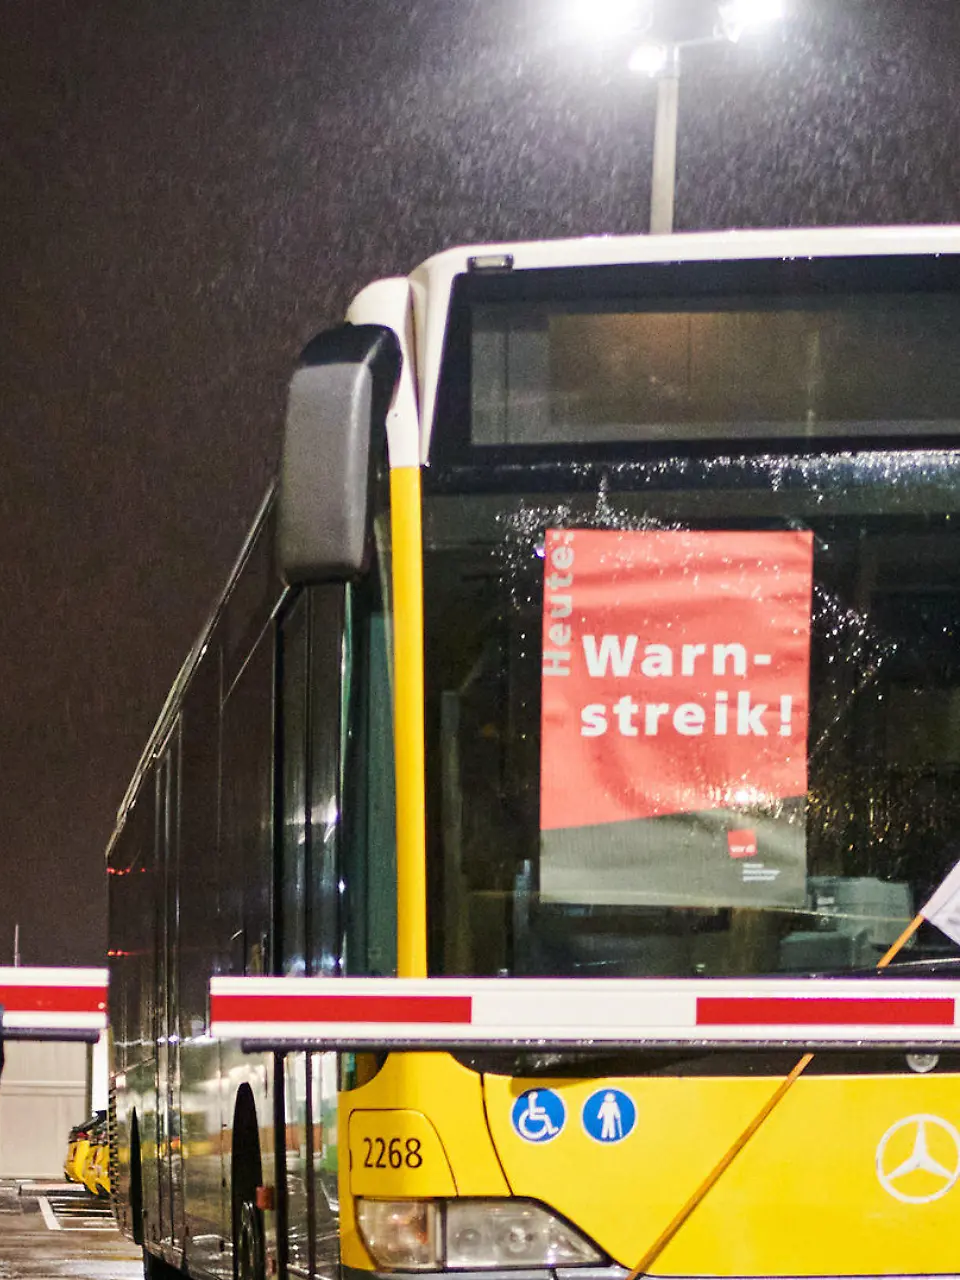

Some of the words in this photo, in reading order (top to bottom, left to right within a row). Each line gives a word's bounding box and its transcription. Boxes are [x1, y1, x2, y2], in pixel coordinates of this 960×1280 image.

[543, 531, 574, 677] Heute:
[581, 634, 772, 678] Warn-
[580, 691, 793, 738] streik!
[363, 1137, 423, 1170] 2268
